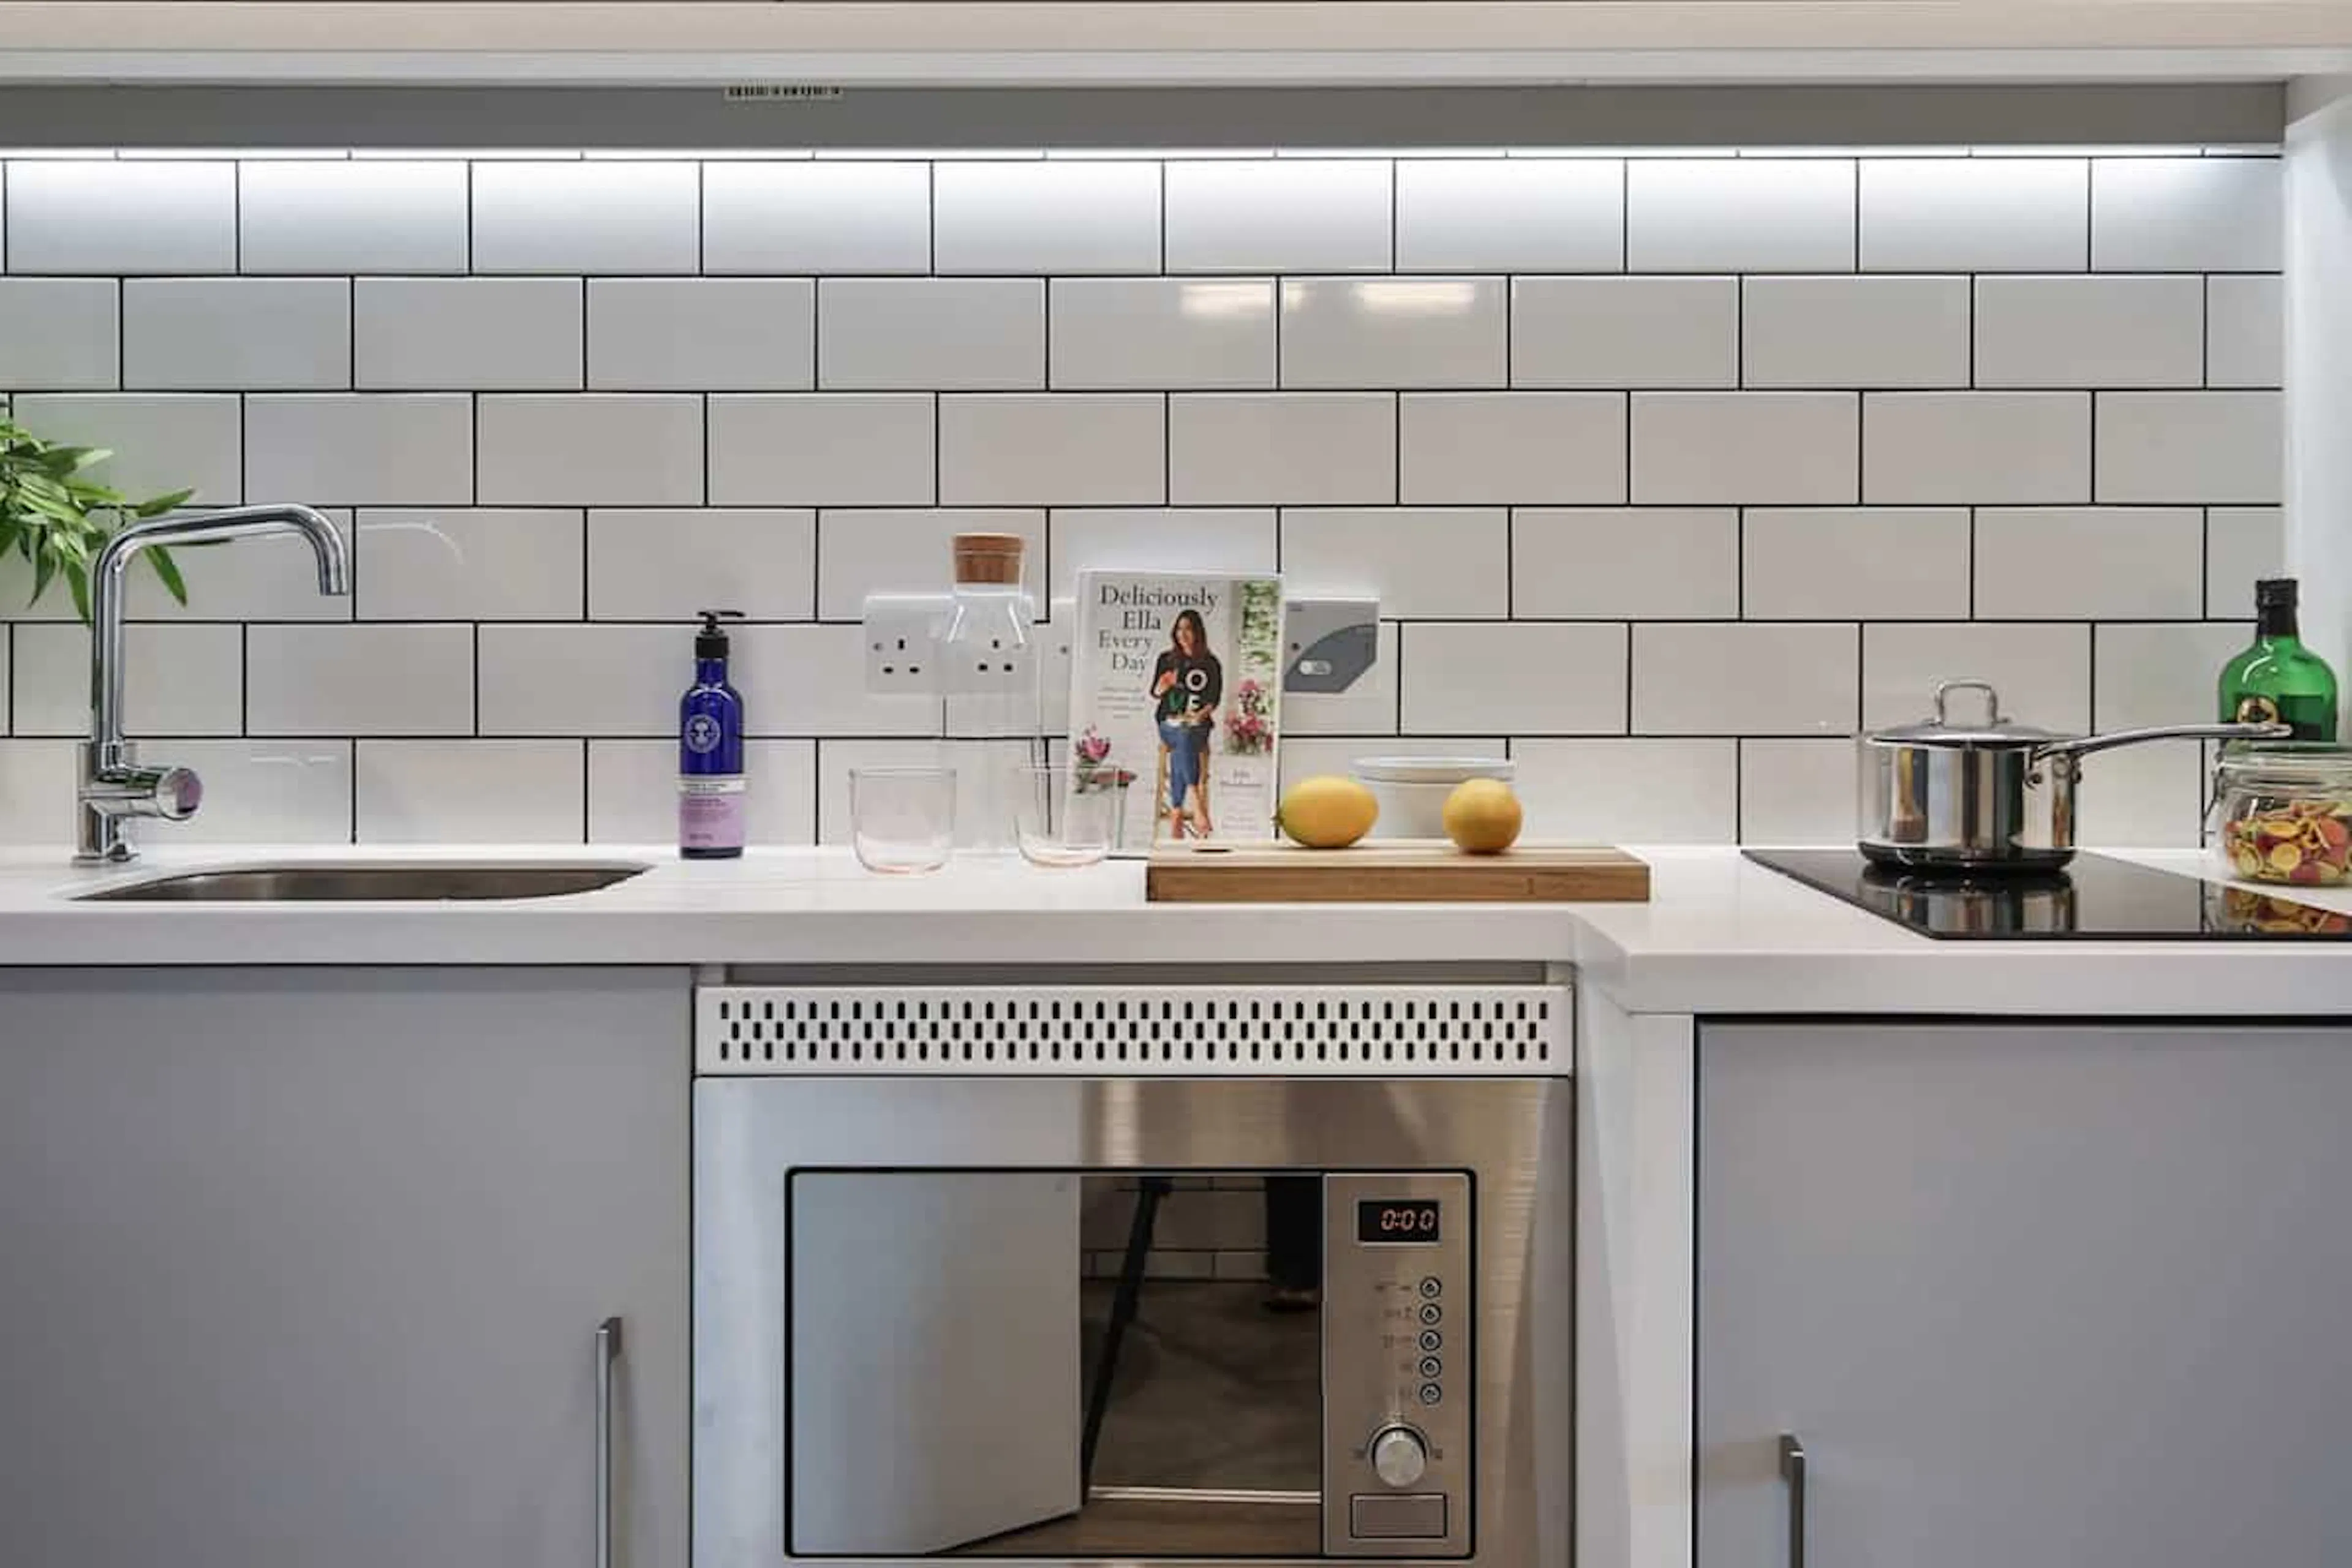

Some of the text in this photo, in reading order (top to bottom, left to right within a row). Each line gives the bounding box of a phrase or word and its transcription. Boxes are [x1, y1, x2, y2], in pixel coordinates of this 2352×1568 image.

[1101, 585, 1219, 614] Deliciously
[1123, 610, 1161, 630] Ella
[1099, 629, 1152, 655] Every
[1112, 653, 1148, 676] Day
[1380, 1208, 1436, 1231] 0:00
